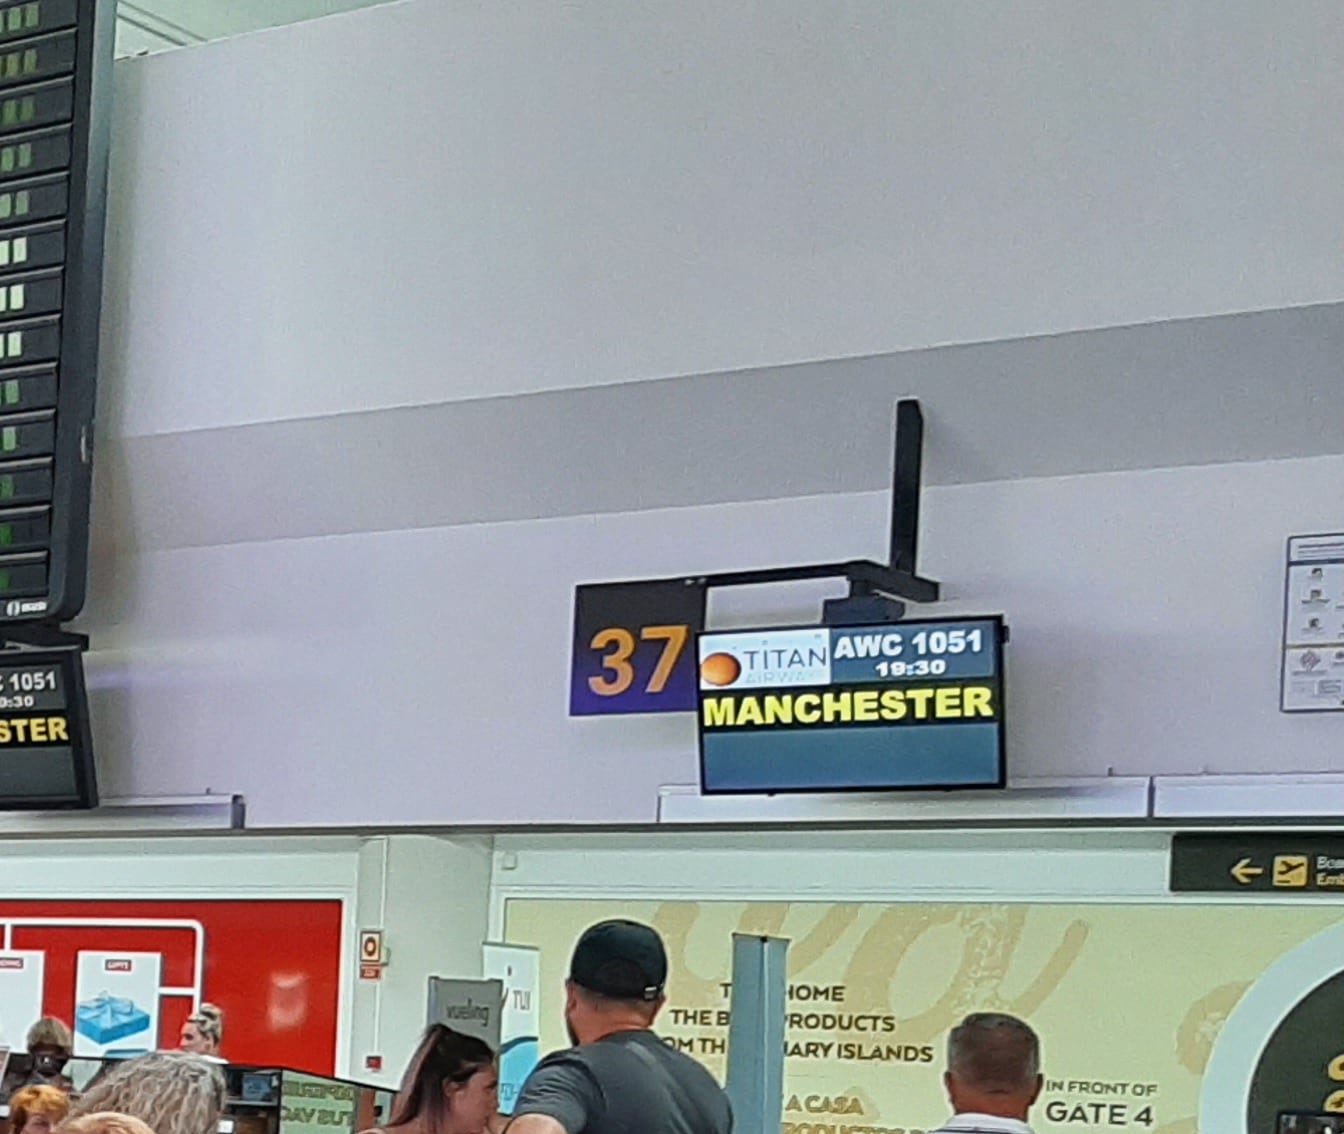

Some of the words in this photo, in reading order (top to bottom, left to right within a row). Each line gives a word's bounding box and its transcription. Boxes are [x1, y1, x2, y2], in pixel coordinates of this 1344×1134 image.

[834, 635, 903, 659] AWC
[912, 630, 981, 655] 1051
[588, 625, 689, 697] 37
[744, 647, 827, 670] TITAN
[876, 660, 945, 676] 19:30
[10, 671, 56, 691] 1051
[704, 687, 993, 727] MANCHESTER
[446, 998, 489, 1027] vueling
[670, 1009, 713, 1026] THE
[837, 1044, 934, 1063] ISLANDS
[1046, 1080, 1064, 1091] IN
[1068, 1081, 1129, 1094] FRONT
[1132, 1083, 1157, 1096] OF
[804, 1095, 865, 1115] CASA
[1046, 1101, 1127, 1125] GATE
[1134, 1105, 1153, 1126] 4
